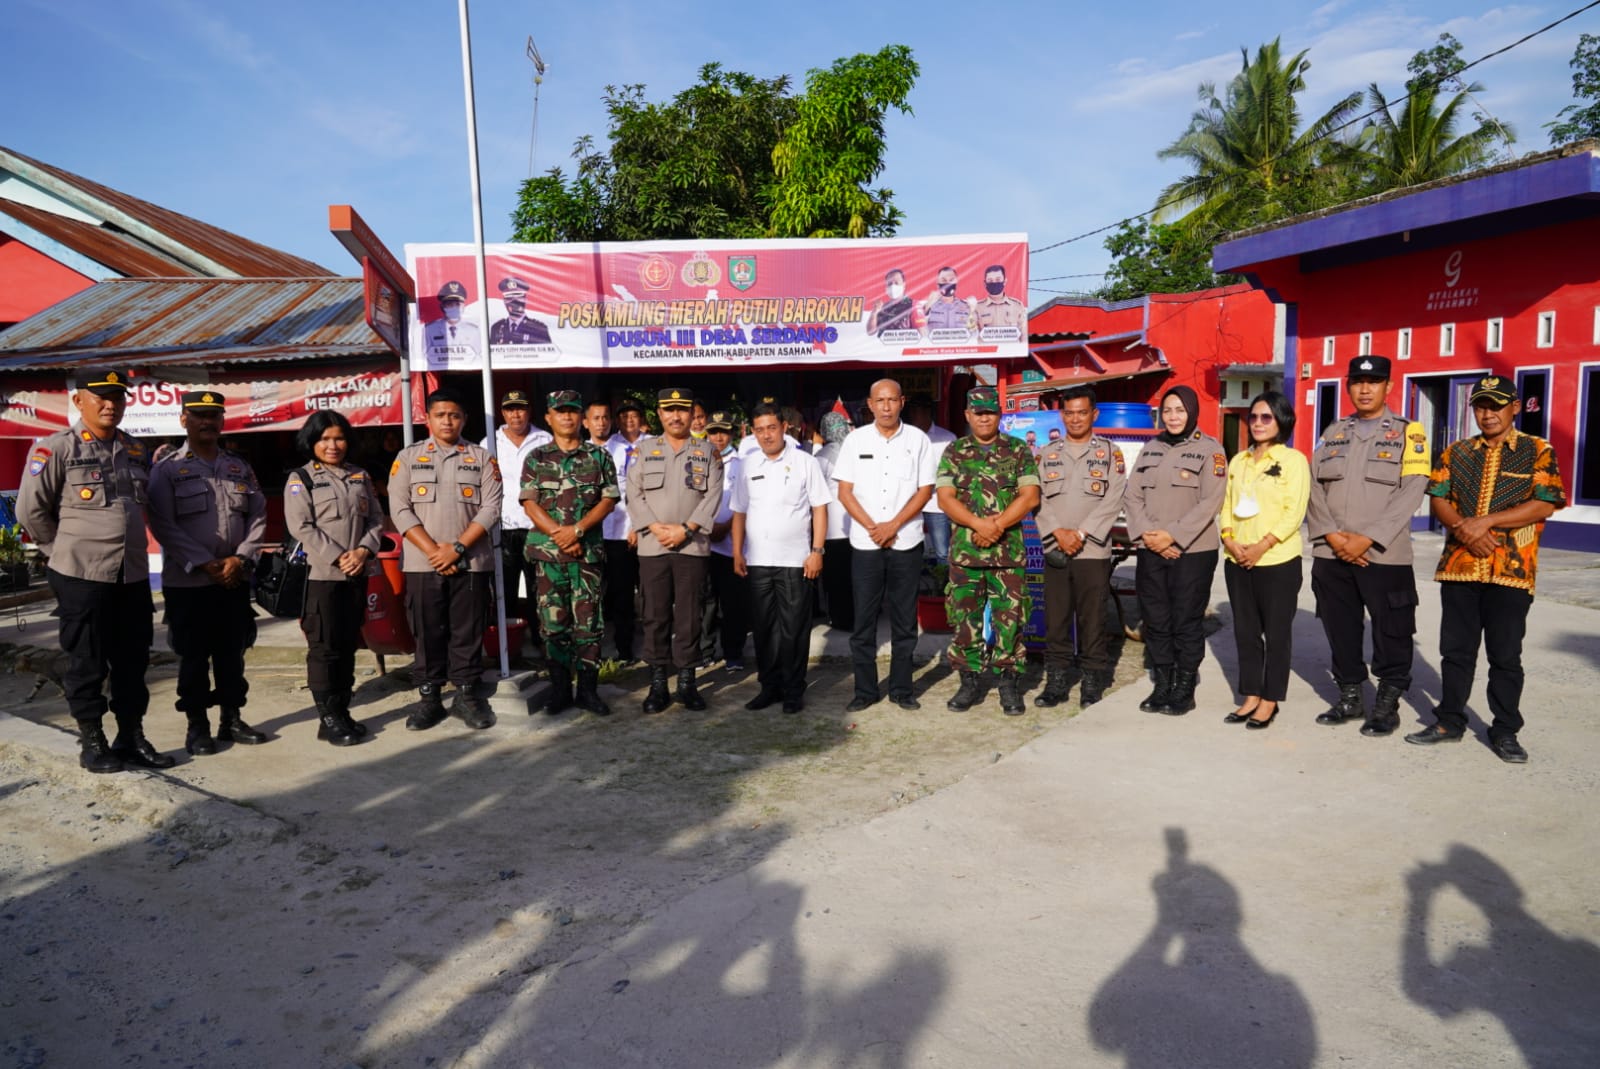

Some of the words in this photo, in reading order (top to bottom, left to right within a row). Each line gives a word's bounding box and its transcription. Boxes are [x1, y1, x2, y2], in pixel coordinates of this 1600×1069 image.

[558, 301, 666, 328] POSKAMLING
[669, 299, 729, 326] MERAH
[731, 298, 780, 325] PUTIH
[782, 297, 864, 323] BAROKAH
[607, 330, 671, 347] DUSUN
[676, 329, 695, 346] III
[701, 328, 747, 345] DESA
[751, 326, 839, 345] SERDANG
[633, 350, 684, 359] KECAMATAN
[777, 346, 813, 356] ASAHAN
[305, 377, 392, 395] NYALAKAN
[305, 393, 392, 410] MERAHMU!
[1375, 441, 1402, 449] POLRI
[687, 455, 708, 463] POLRI
[1181, 452, 1205, 461] POLRI
